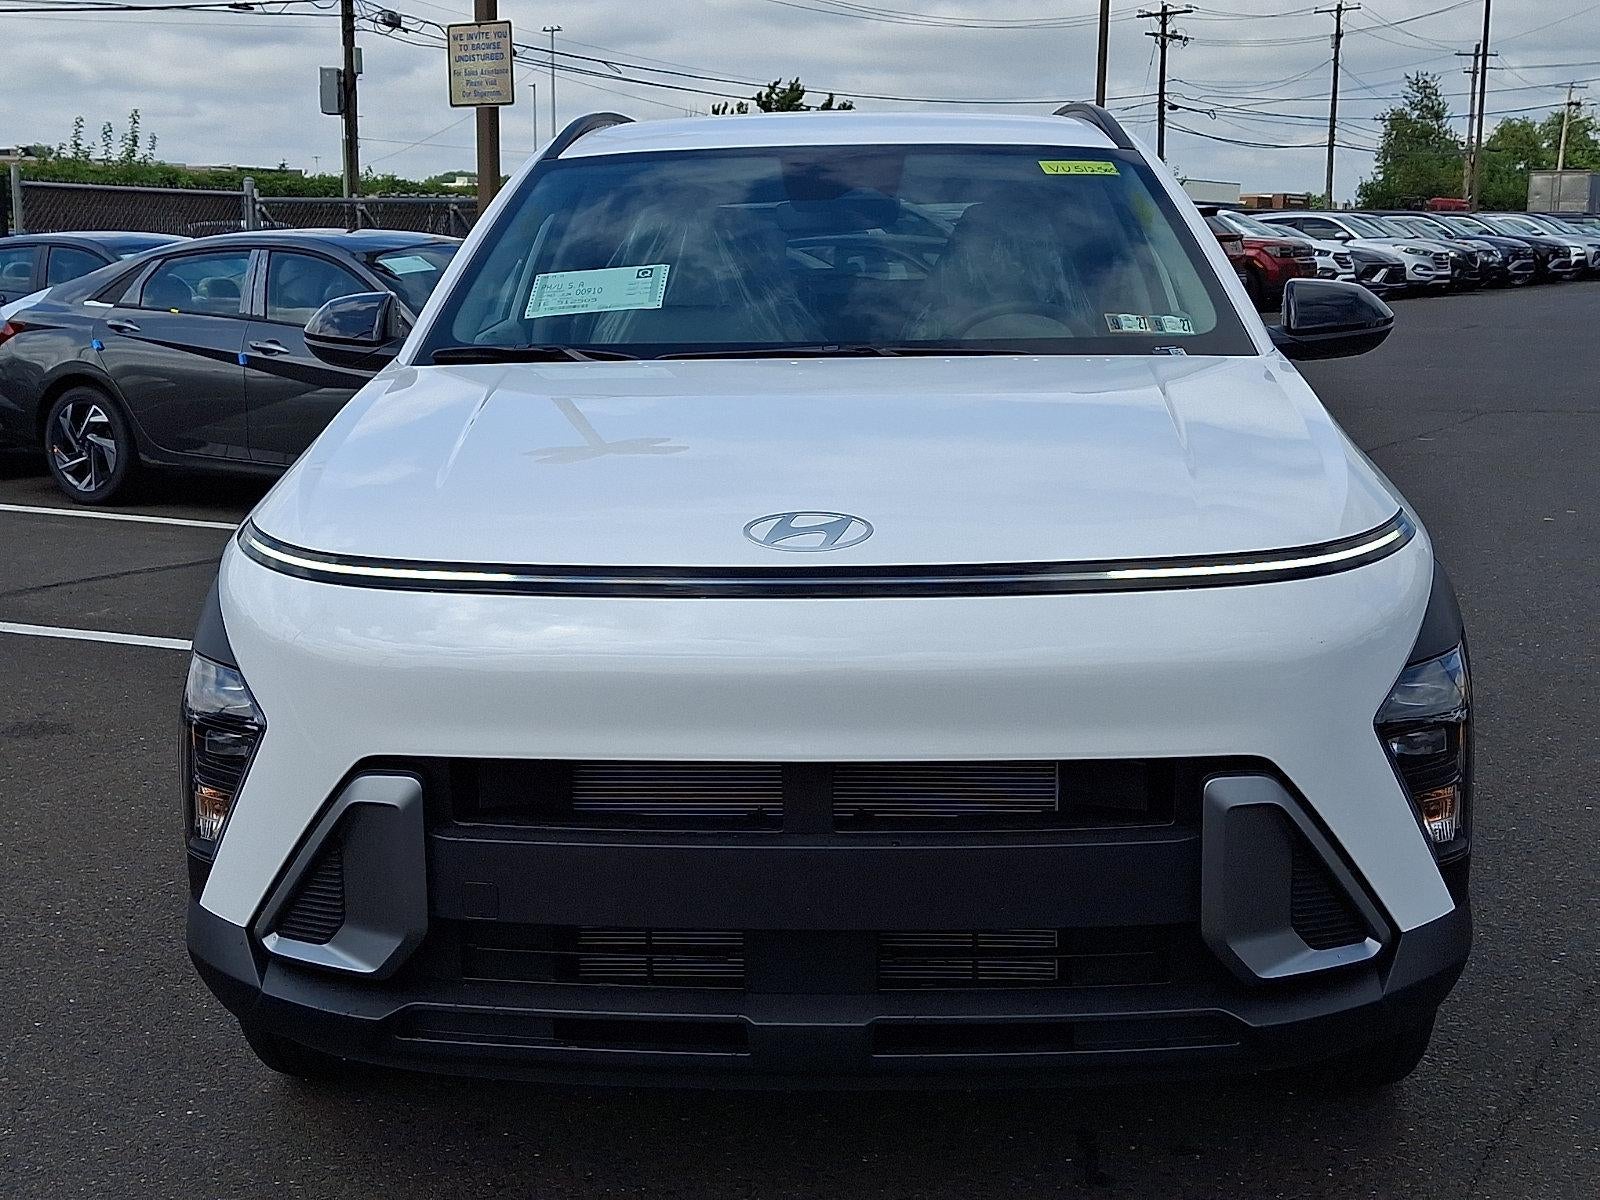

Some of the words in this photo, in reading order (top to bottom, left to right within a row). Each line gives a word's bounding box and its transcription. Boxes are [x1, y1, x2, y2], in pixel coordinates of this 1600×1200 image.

[452, 33, 464, 42] WE
[466, 31, 490, 41] INVITE
[493, 30, 508, 39] YOU
[459, 44, 469, 52] TO
[471, 41, 502, 51] BROWSE
